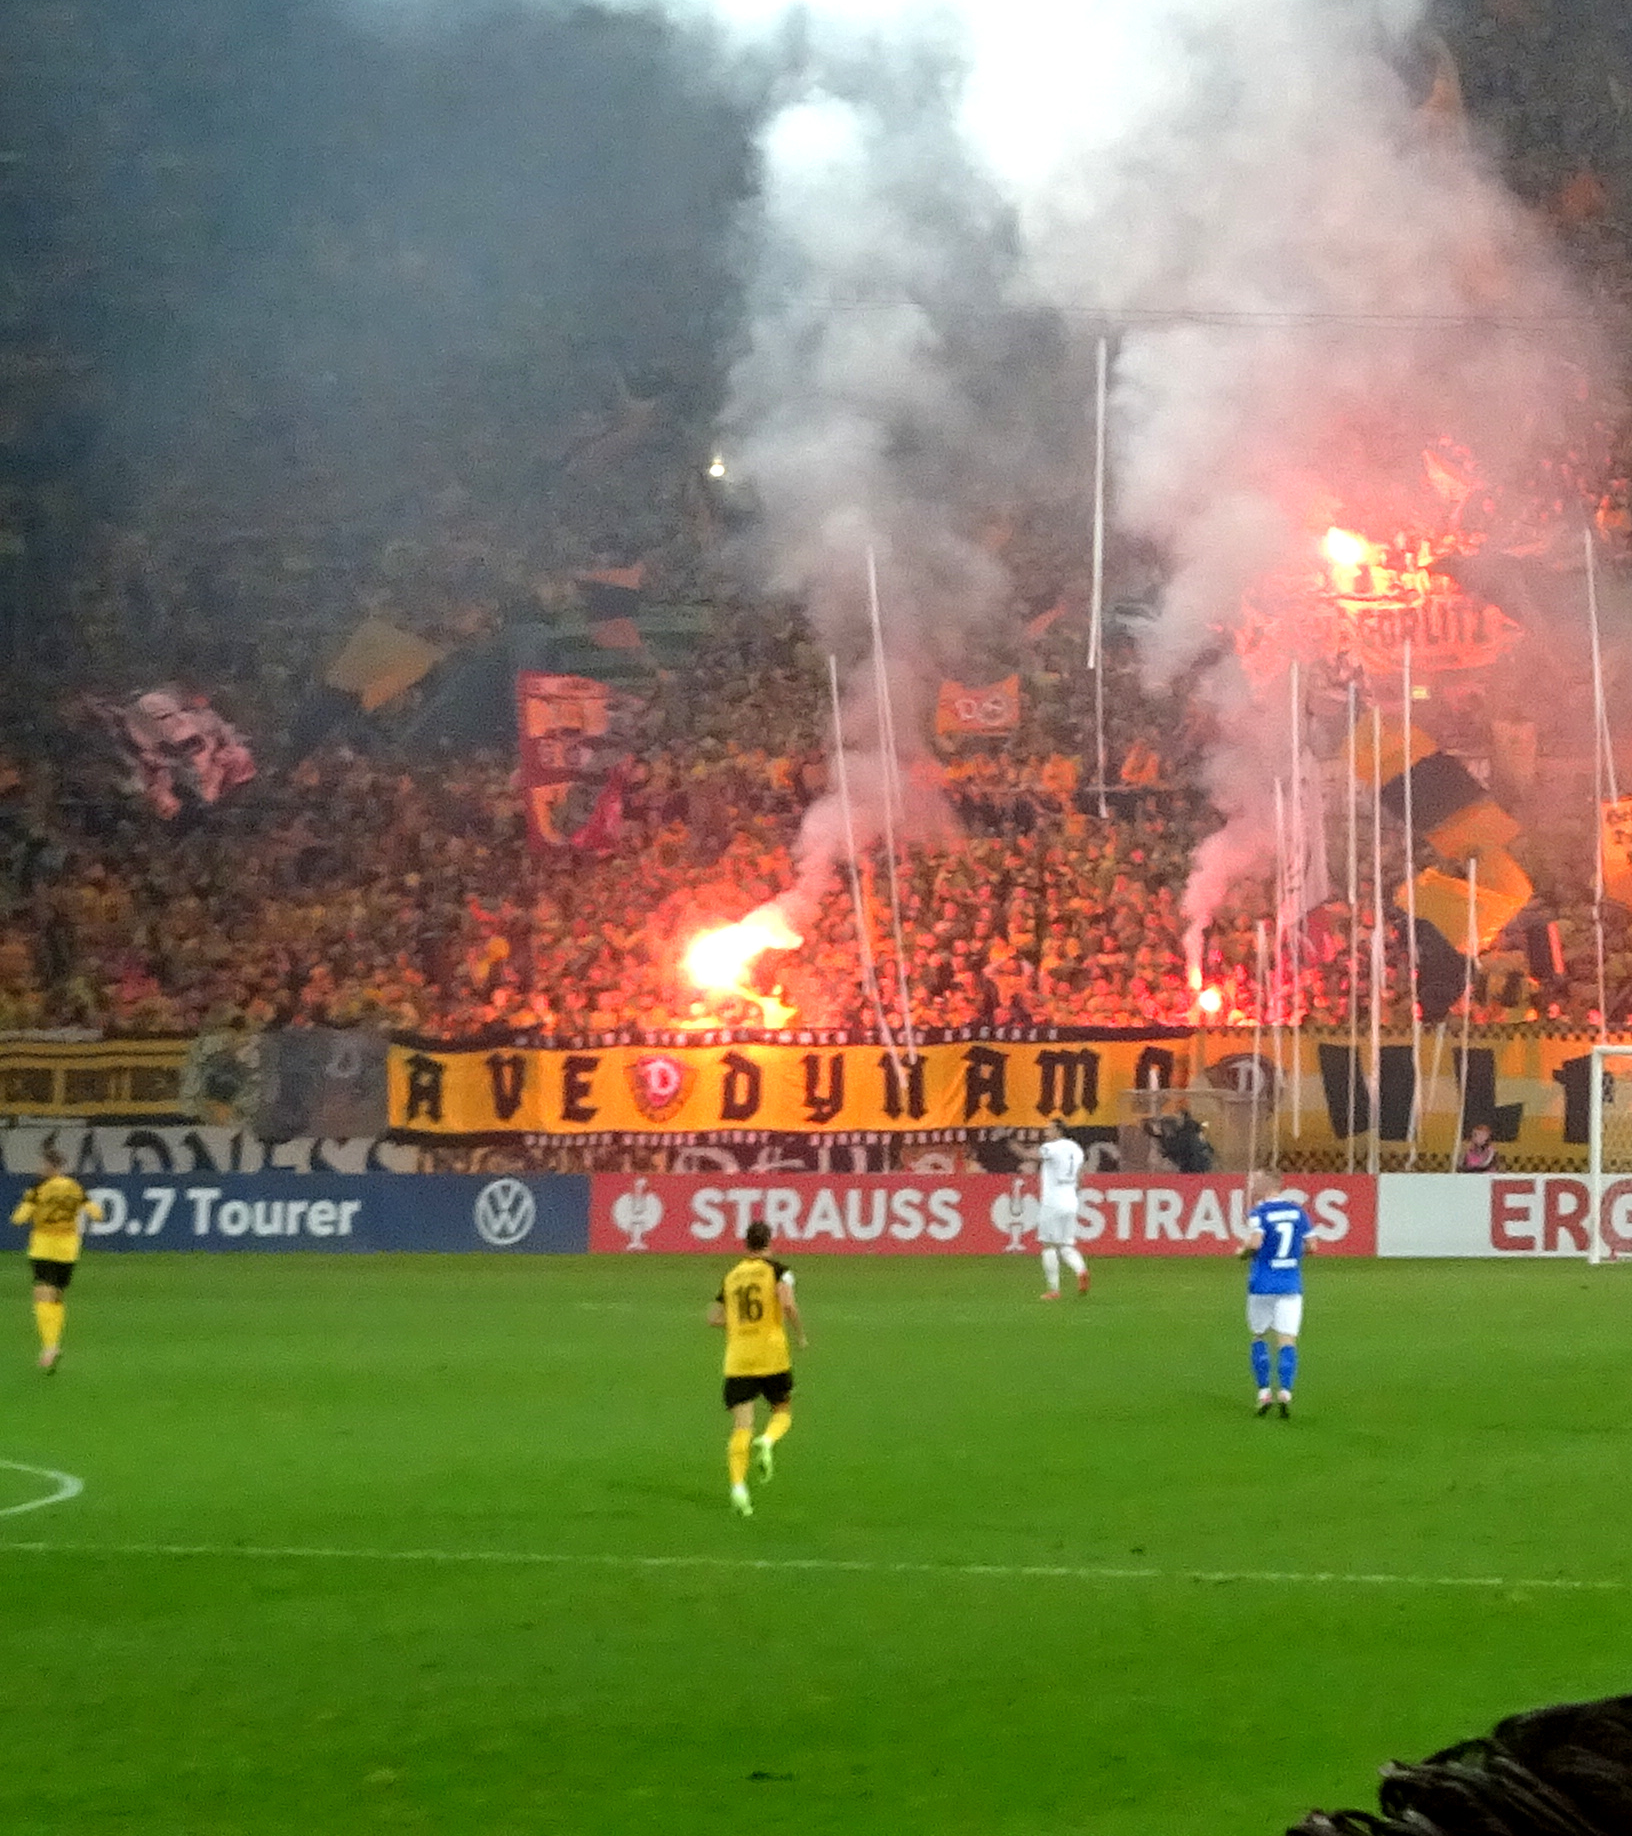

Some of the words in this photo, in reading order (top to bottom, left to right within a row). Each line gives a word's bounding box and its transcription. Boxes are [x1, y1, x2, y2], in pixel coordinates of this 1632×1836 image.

[186, 1186, 362, 1237] Tourer
[691, 1186, 963, 1241] STRAUSS
[1076, 1187, 1348, 1241] STRAUS
[734, 1282, 763, 1324] 16
